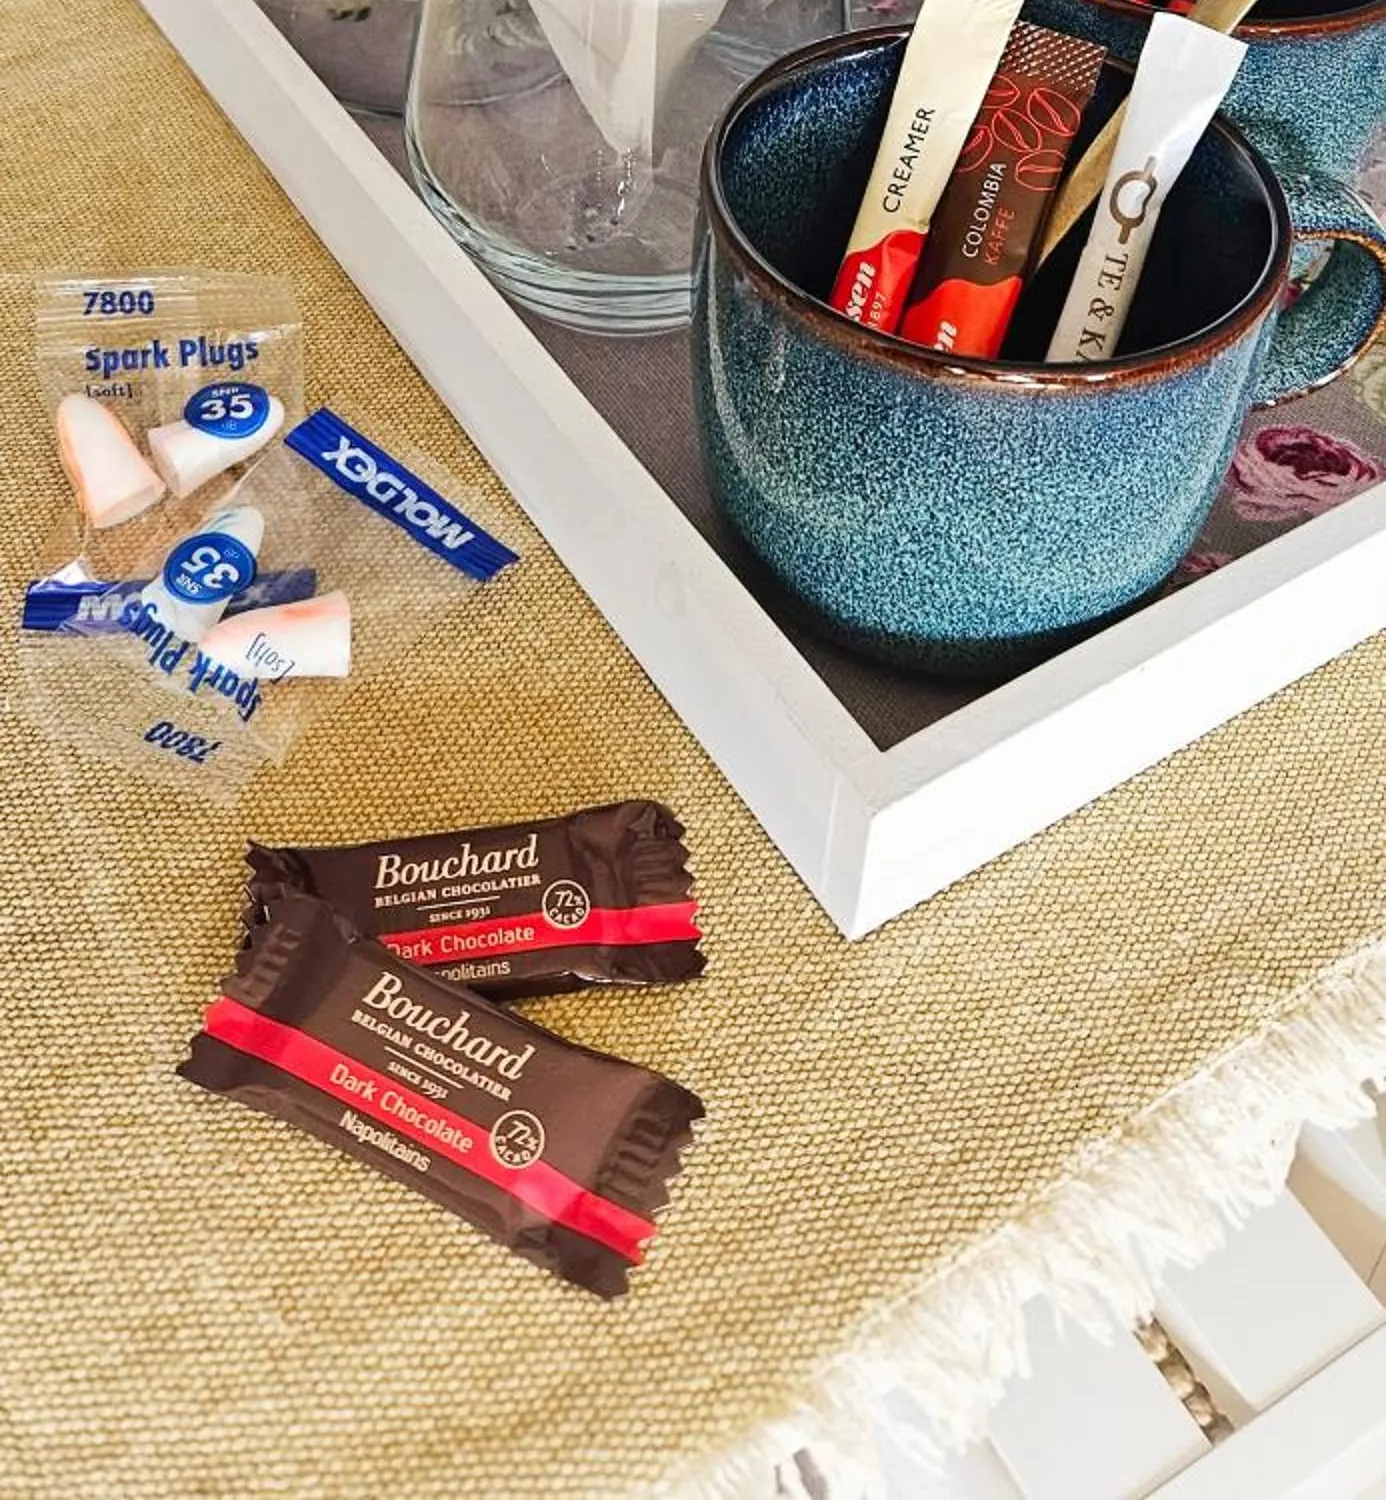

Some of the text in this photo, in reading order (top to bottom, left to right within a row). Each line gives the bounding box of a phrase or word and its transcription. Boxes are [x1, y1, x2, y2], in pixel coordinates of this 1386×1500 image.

[883, 106, 936, 213] CREAMER
[962, 162, 1007, 259] COLOMBIA
[984, 206, 1015, 266] KAFFE
[1098, 253, 1129, 291] TE
[82, 291, 155, 316] 7800
[1087, 297, 1115, 322] &
[85, 336, 260, 379] Spark Plugs
[201, 393, 254, 421] 35
[320, 435, 475, 551] MOLDEX
[180, 546, 240, 589] 35
[118, 601, 190, 676] Plugs
[143, 721, 223, 763] 7800
[374, 833, 539, 890] Bouchard
[374, 873, 542, 909] BELGIAN CHOCOLATIER
[428, 906, 491, 923] SINCE 1931
[549, 907, 585, 925] CACAO
[440, 926, 536, 954] Chocolate
[362, 971, 537, 1081] Bouchard
[351, 1009, 513, 1102] BELGIAN CHOCOLATIER
[386, 1061, 449, 1100] SINCE 1931
[329, 1063, 474, 1154] Dark Chocolate
[338, 1109, 432, 1173] Napolitains
[494, 1134, 532, 1164] CACAO
